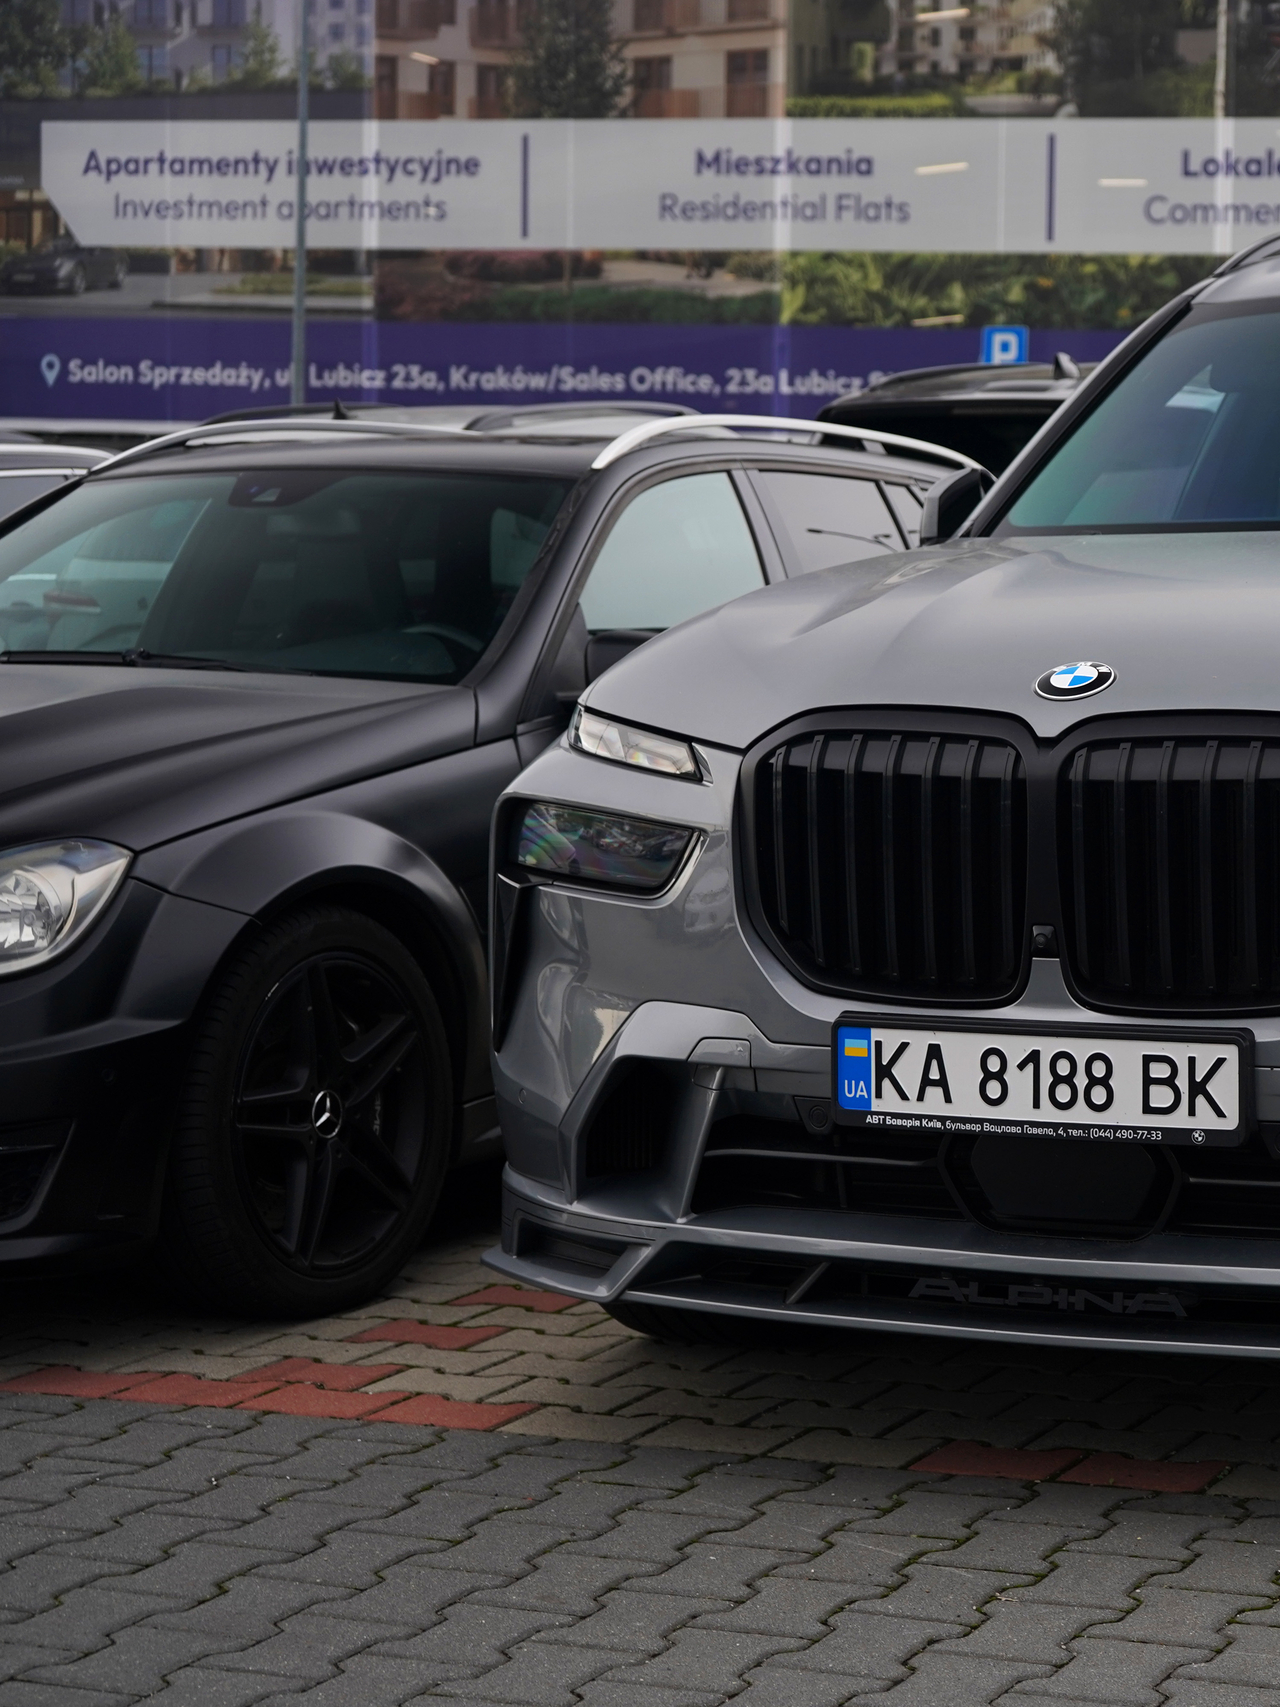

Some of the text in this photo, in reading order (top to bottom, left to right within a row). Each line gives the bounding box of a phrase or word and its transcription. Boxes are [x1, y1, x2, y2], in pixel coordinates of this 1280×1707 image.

[81, 149, 279, 184] Apartamenty
[694, 147, 875, 177] Mieszkania
[113, 192, 270, 220] Investment
[658, 193, 911, 222] Residential Flats
[992, 332, 1020, 366] P
[68, 358, 133, 384] Salon
[137, 359, 271, 393] Sprzedaży,
[308, 362, 387, 388] Lubicz
[390, 363, 446, 394] 23a,
[450, 363, 626, 394] Kraków/Sales
[629, 365, 721, 396] Office,
[724, 367, 774, 394] 23a
[778, 369, 864, 396] Lubicz
[844, 1079, 869, 1100] UA
[872, 1038, 1229, 1119] KA 8188 BK
[885, 1116, 921, 1128] Баварія
[921, 1118, 944, 1130] Київ,
[945, 1120, 982, 1133] бульвар
[983, 1122, 1022, 1134] Вацлава
[1023, 1125, 1057, 1137] Гавела,
[1057, 1127, 1066, 1138] 4,
[1089, 1128, 1114, 1140] (044)
[1115, 1129, 1162, 1140] 490-77-33
[907, 1277, 1188, 1318] ALPINA
